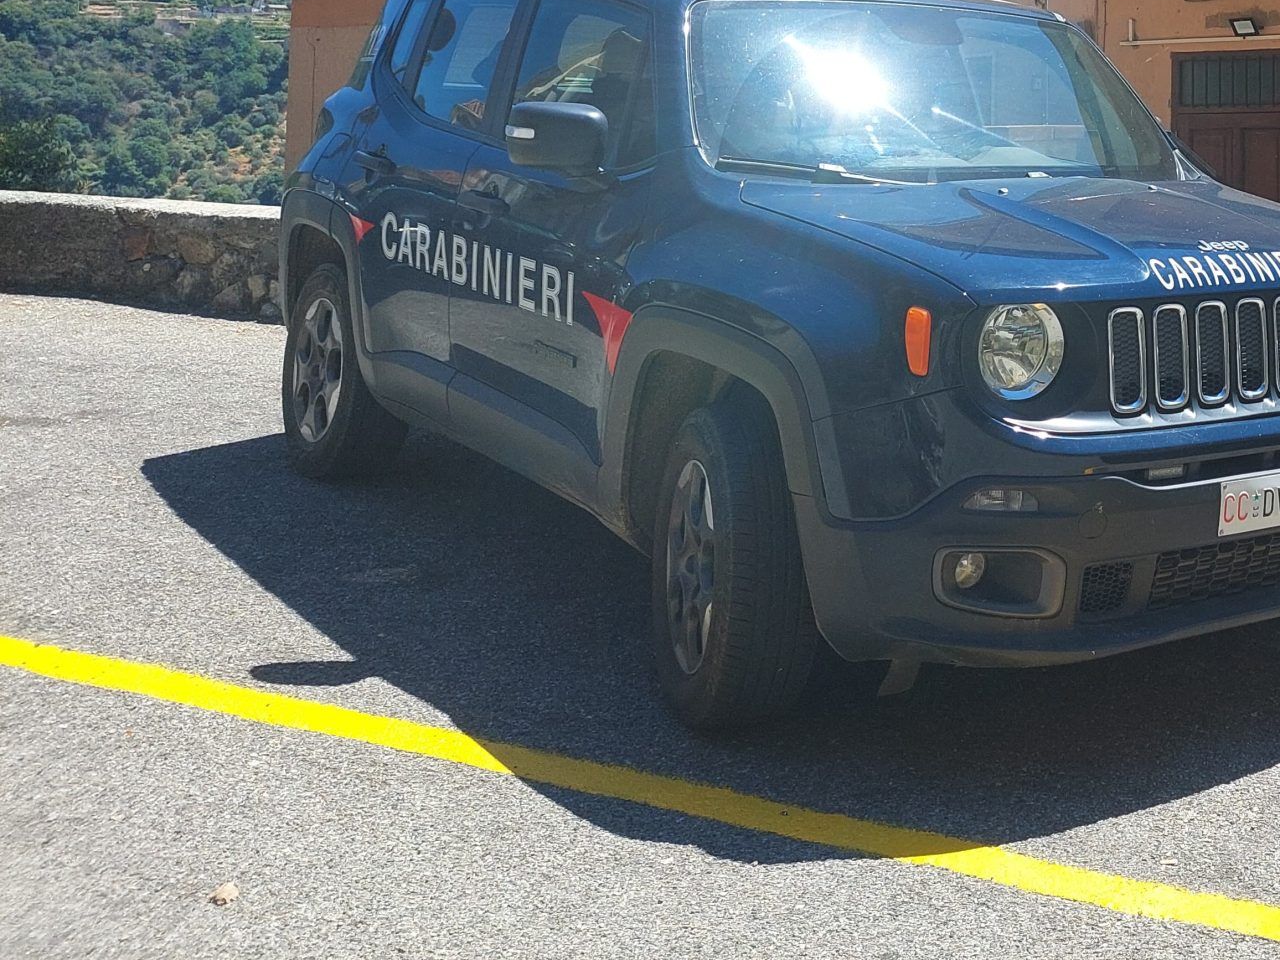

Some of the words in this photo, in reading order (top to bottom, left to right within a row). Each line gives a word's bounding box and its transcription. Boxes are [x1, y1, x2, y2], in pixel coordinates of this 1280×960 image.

[1197, 239, 1249, 253] Jeep
[381, 211, 575, 326] CARABINIERI
[1223, 493, 1249, 524] CC
